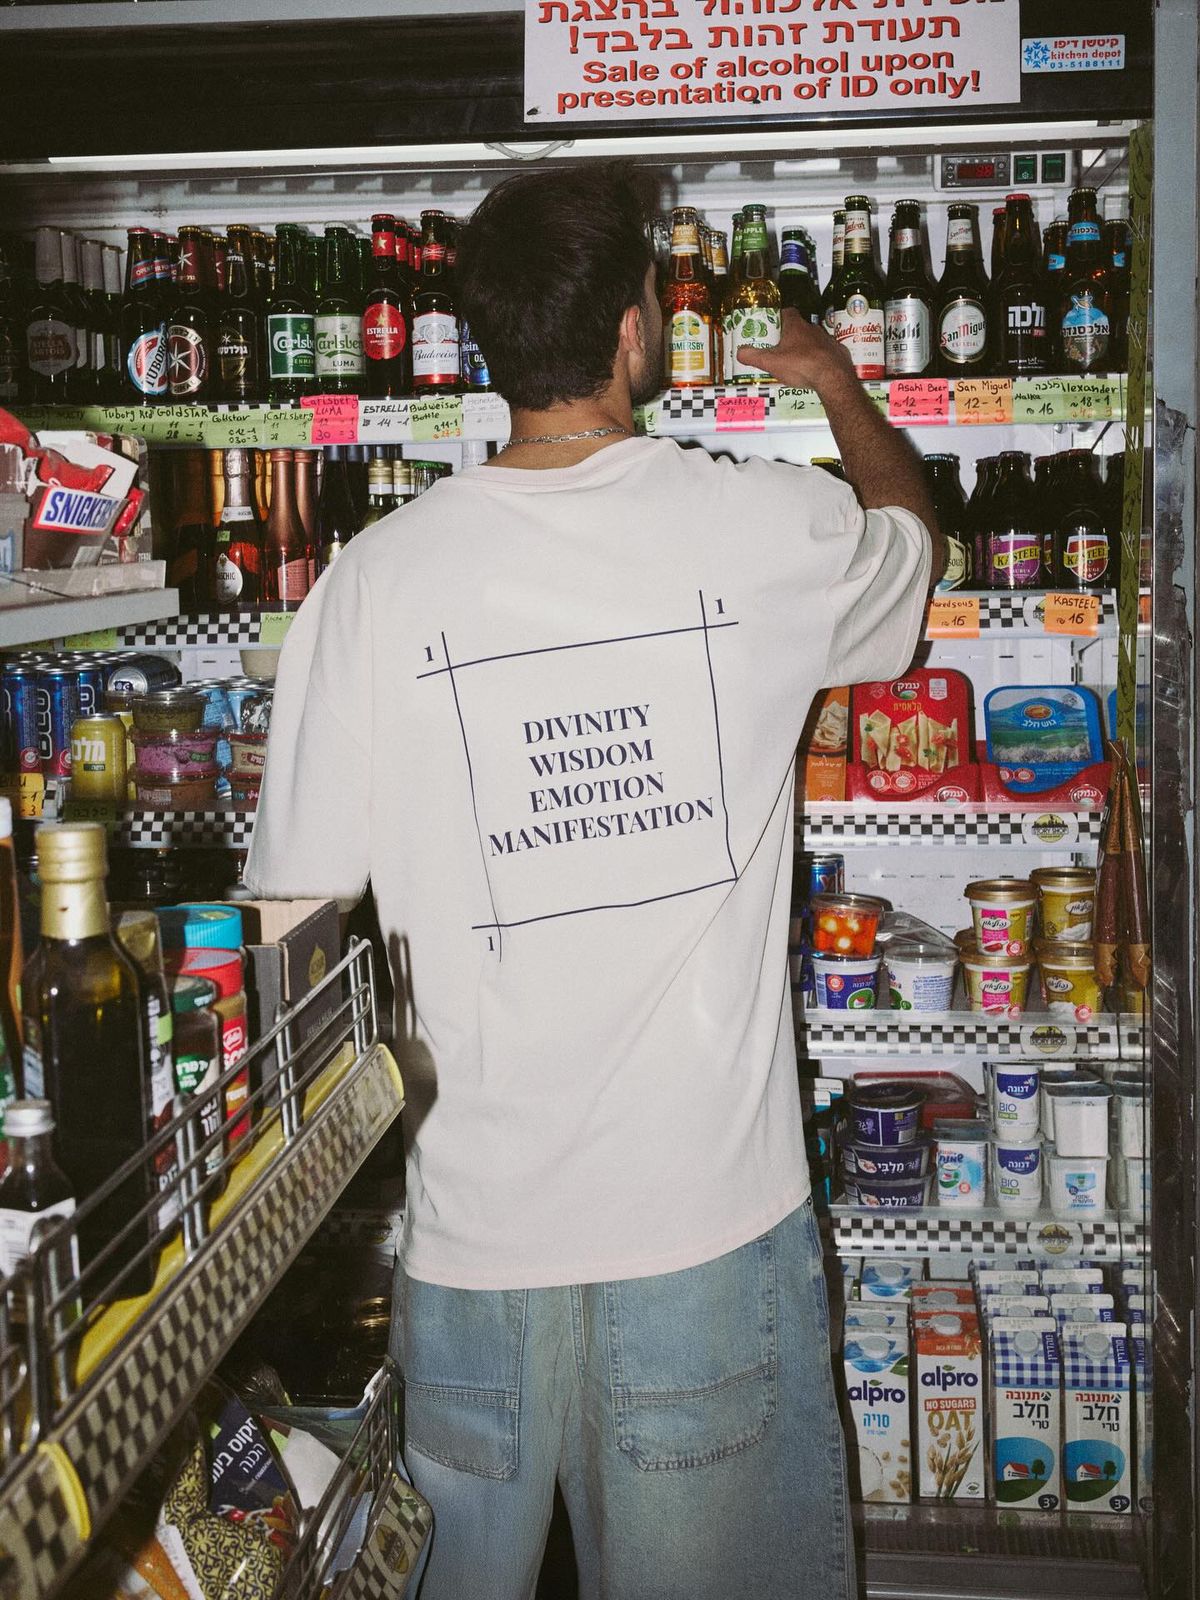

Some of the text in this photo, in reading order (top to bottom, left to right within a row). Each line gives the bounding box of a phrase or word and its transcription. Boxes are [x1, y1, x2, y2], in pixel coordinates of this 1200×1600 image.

[569, 16, 960, 54] תעודת זהות בלבד!
[1051, 49, 1121, 60] kitchen depot
[583, 51, 955, 84] Sale of alcohol upon
[1050, 59, 1121, 69] 03-5188111
[557, 70, 981, 114] presentation of ID only!
[366, 327, 399, 335] ESTRELLA
[668, 341, 705, 351] SOMERSBY
[414, 349, 458, 361] Budweiser
[332, 360, 355, 368] LUMA
[897, 381, 923, 392] Asahi
[956, 380, 1012, 393] San Miguel
[363, 403, 409, 414] ESTRELLA
[409, 400, 462, 414] Budweiser
[103, 408, 135, 422] Tuborg
[997, 548, 1040, 566] KASTEEL
[714, 598, 726, 615] 1
[1054, 595, 1096, 609] KASTEEL
[424, 645, 435, 662] 1
[897, 681, 920, 690] עמק
[893, 701, 922, 712] קלאסית
[522, 704, 651, 744] DIVINITY
[1022, 719, 1057, 729] גוש חלב
[71, 736, 106, 762] מלכ
[528, 738, 655, 777] WISDOM
[529, 772, 665, 813] EMOTION
[488, 796, 715, 857] MANIFESTATION
[487, 935, 496, 952] 1
[1007, 1084, 1029, 1093] דנונה
[999, 1102, 1017, 1113] BIO
[1008, 1160, 1030, 1169] דנונה
[1001, 1178, 1019, 1188] BIO
[921, 1366, 979, 1391] alpro
[848, 1379, 906, 1407] alpro
[1006, 1390, 1041, 1400] תנובה
[1075, 1392, 1111, 1403] תנובה
[926, 1399, 975, 1410] NO SUGARS
[1012, 1402, 1049, 1419] חלב
[1082, 1403, 1120, 1421] חלב
[863, 1412, 890, 1428] סויה
[927, 1410, 976, 1431] OAT
[1031, 1420, 1050, 1430] טרי
[1101, 1423, 1120, 1432] טרי
[239, 1443, 266, 1473] הכנה
